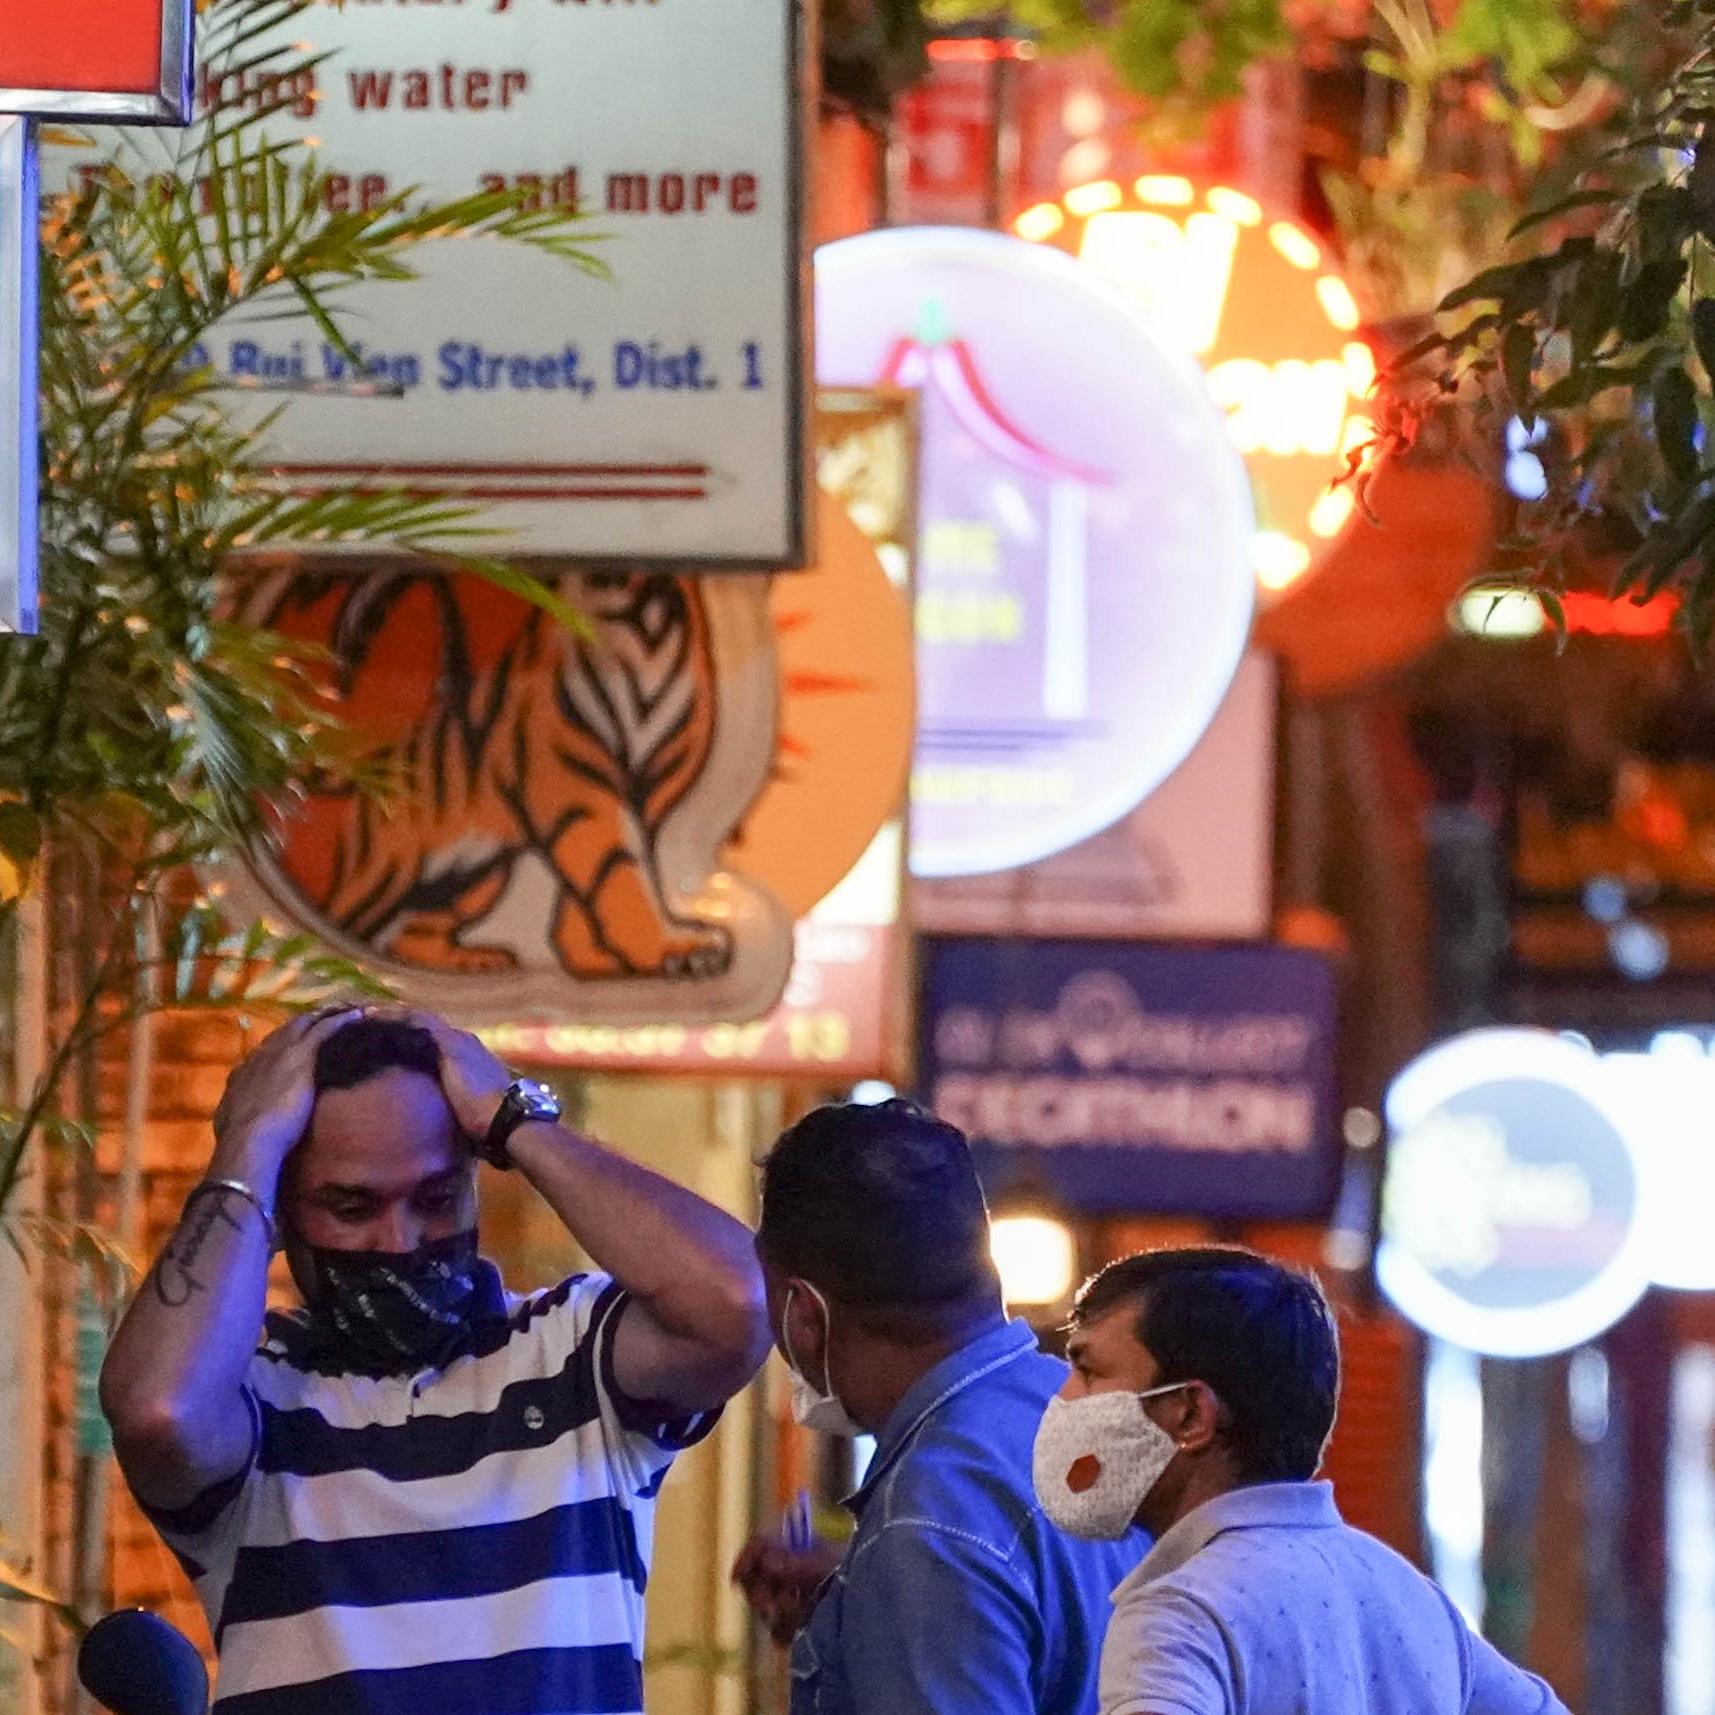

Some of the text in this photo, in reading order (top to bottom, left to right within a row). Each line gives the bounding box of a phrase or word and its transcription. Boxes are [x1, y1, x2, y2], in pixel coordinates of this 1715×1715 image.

[347, 63, 528, 110] water
[605, 171, 759, 214] more
[437, 339, 596, 398] Street,
[613, 340, 718, 391] Dist.
[741, 340, 763, 391] 1
